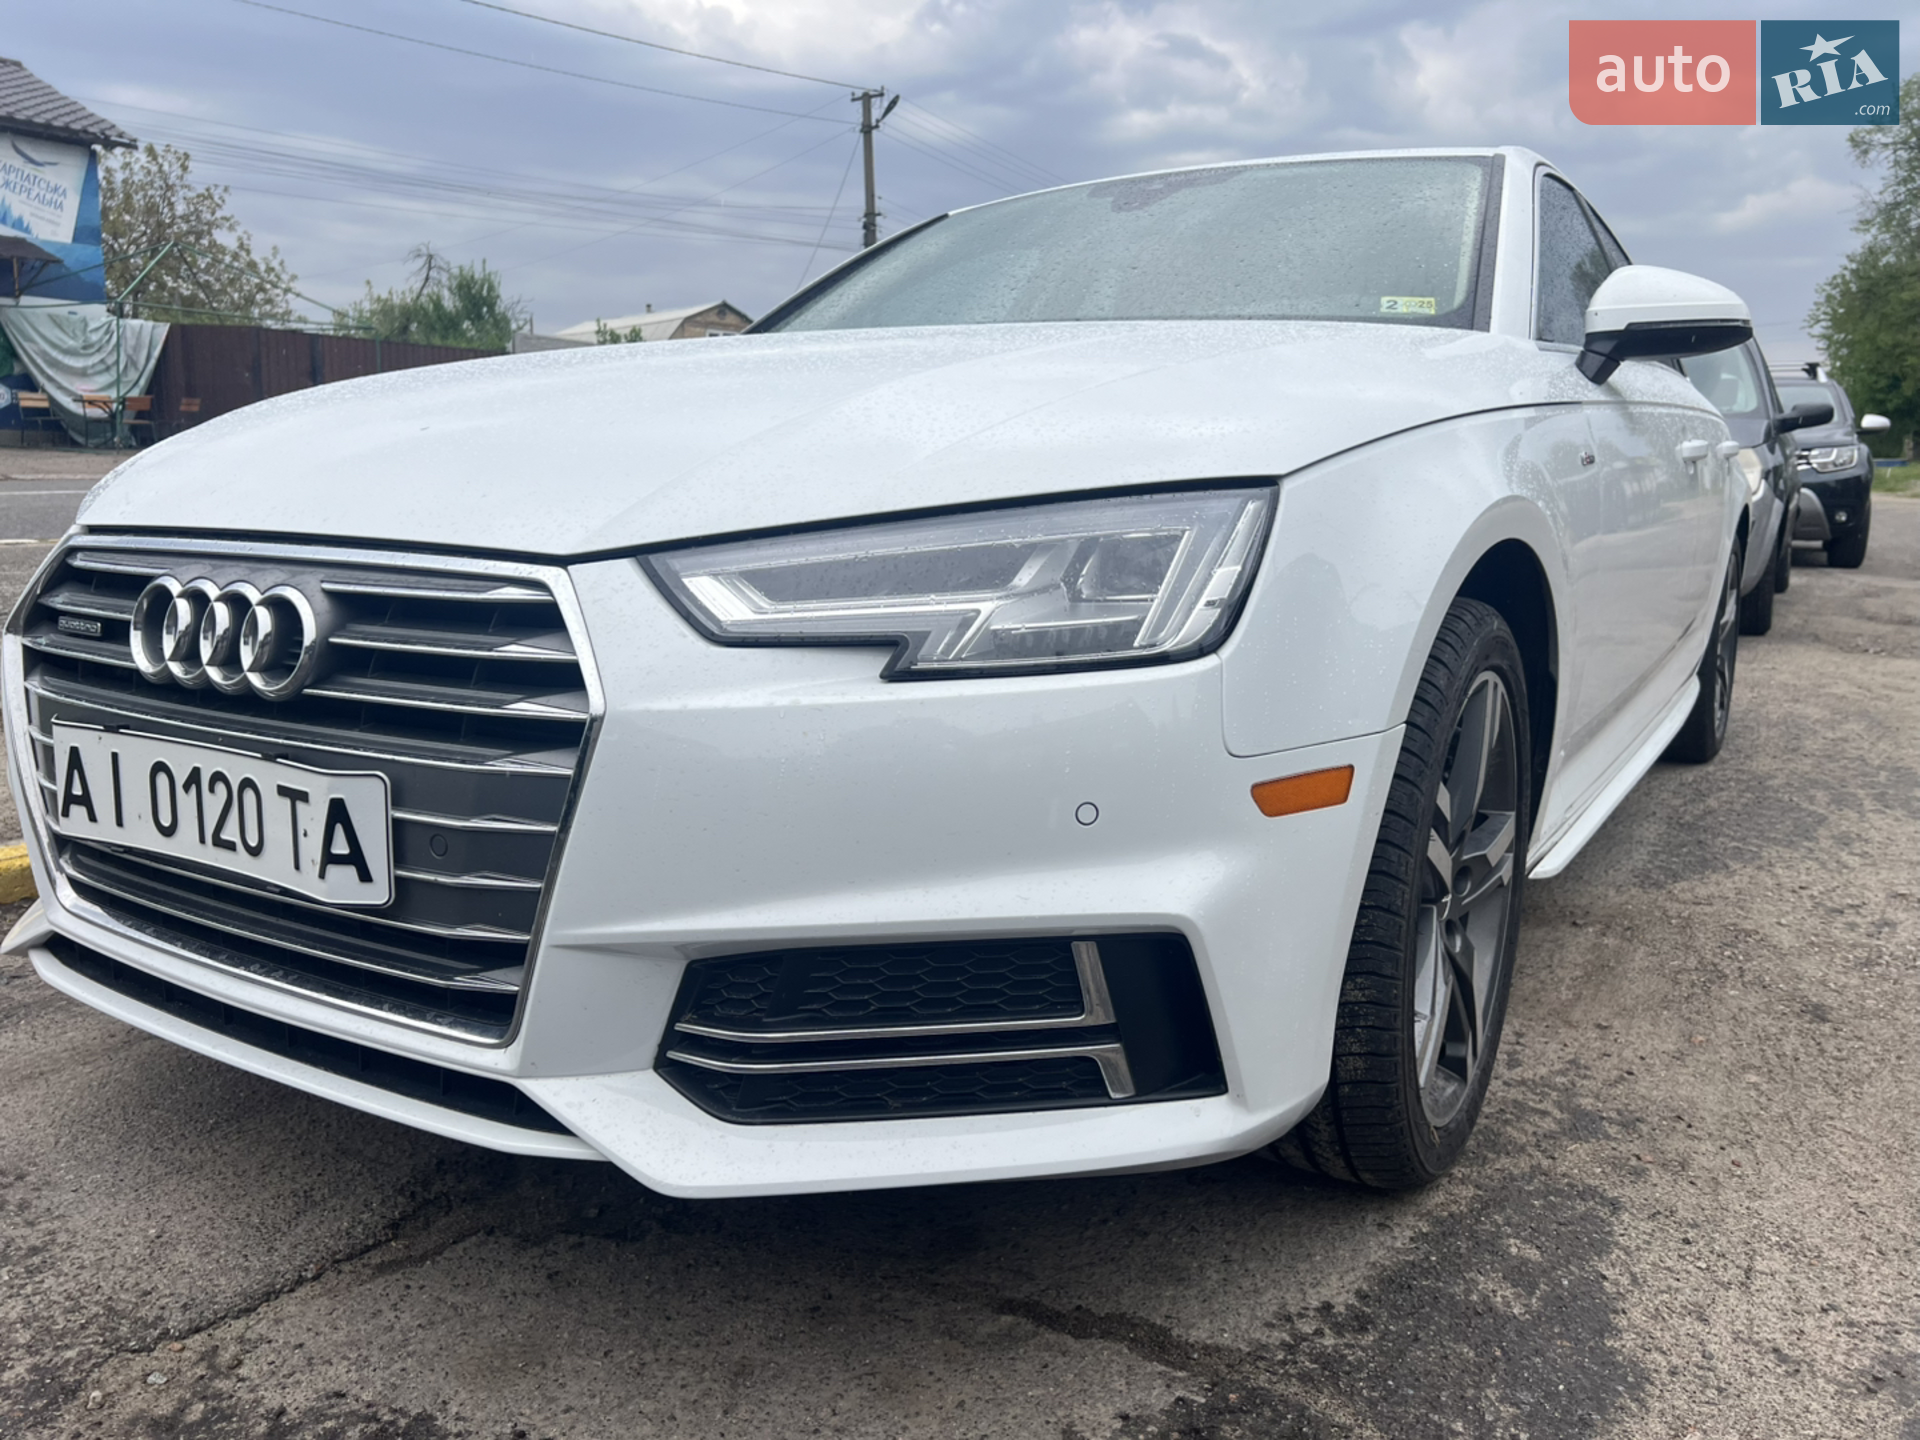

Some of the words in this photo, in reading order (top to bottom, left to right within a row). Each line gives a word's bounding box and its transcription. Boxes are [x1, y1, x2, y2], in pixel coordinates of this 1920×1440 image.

[0, 160, 68, 200] АРПАТСЬКА
[1385, 299, 1398, 310] 2
[149, 759, 265, 858] 0120
[276, 783, 374, 884] TA
